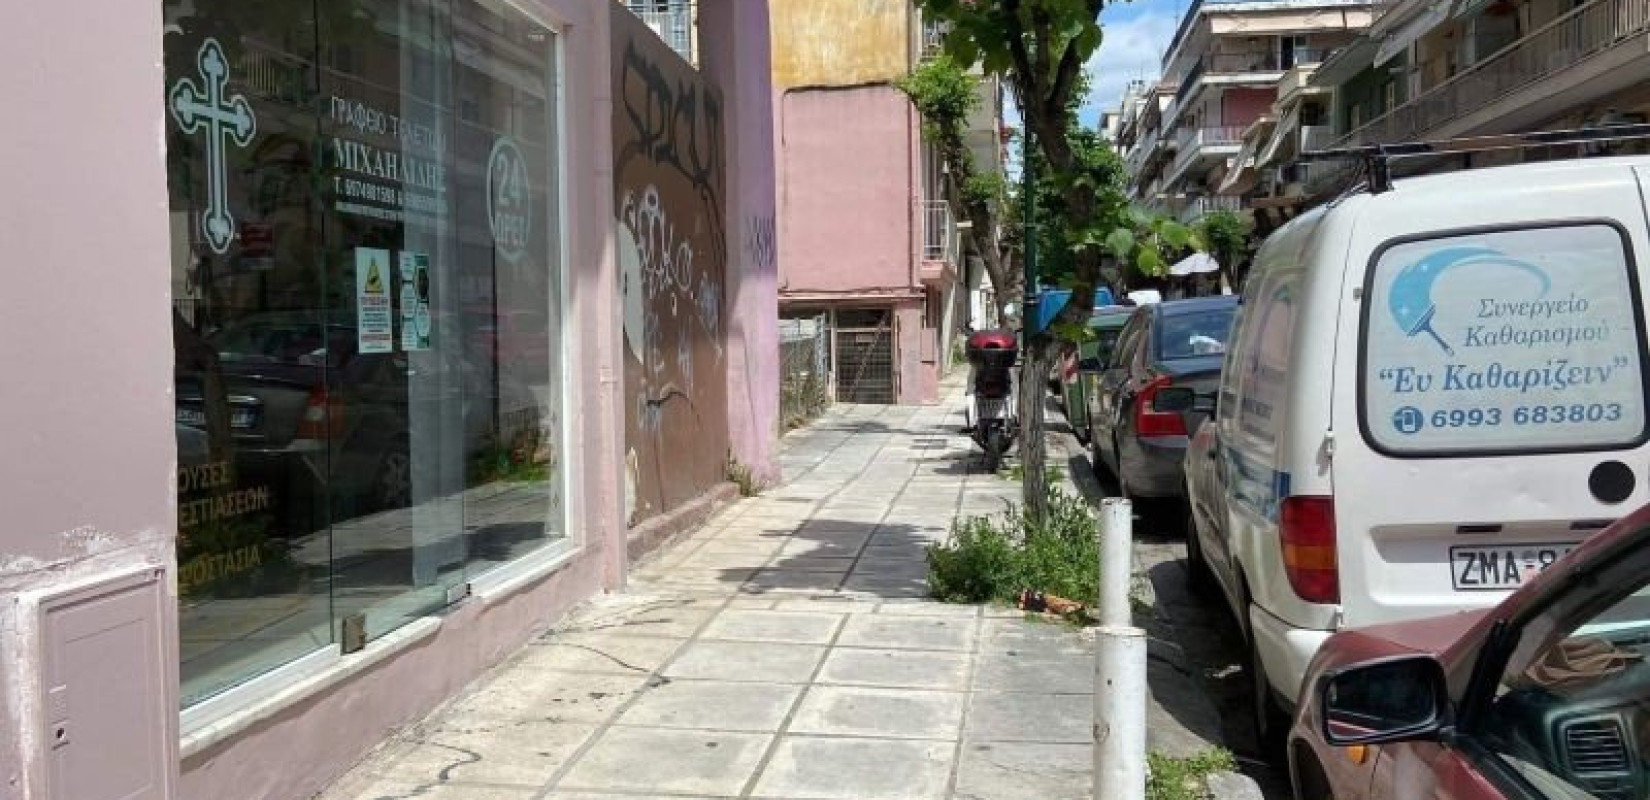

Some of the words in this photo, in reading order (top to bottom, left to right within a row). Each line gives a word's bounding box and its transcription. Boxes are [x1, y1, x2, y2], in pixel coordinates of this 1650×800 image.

[494, 152, 521, 207] 24
[1477, 292, 1589, 319] Συνεργείο
[1463, 320, 1610, 349] Καθαρισμού
[1430, 407, 1502, 429] 6993
[1513, 403, 1623, 425] 683803
